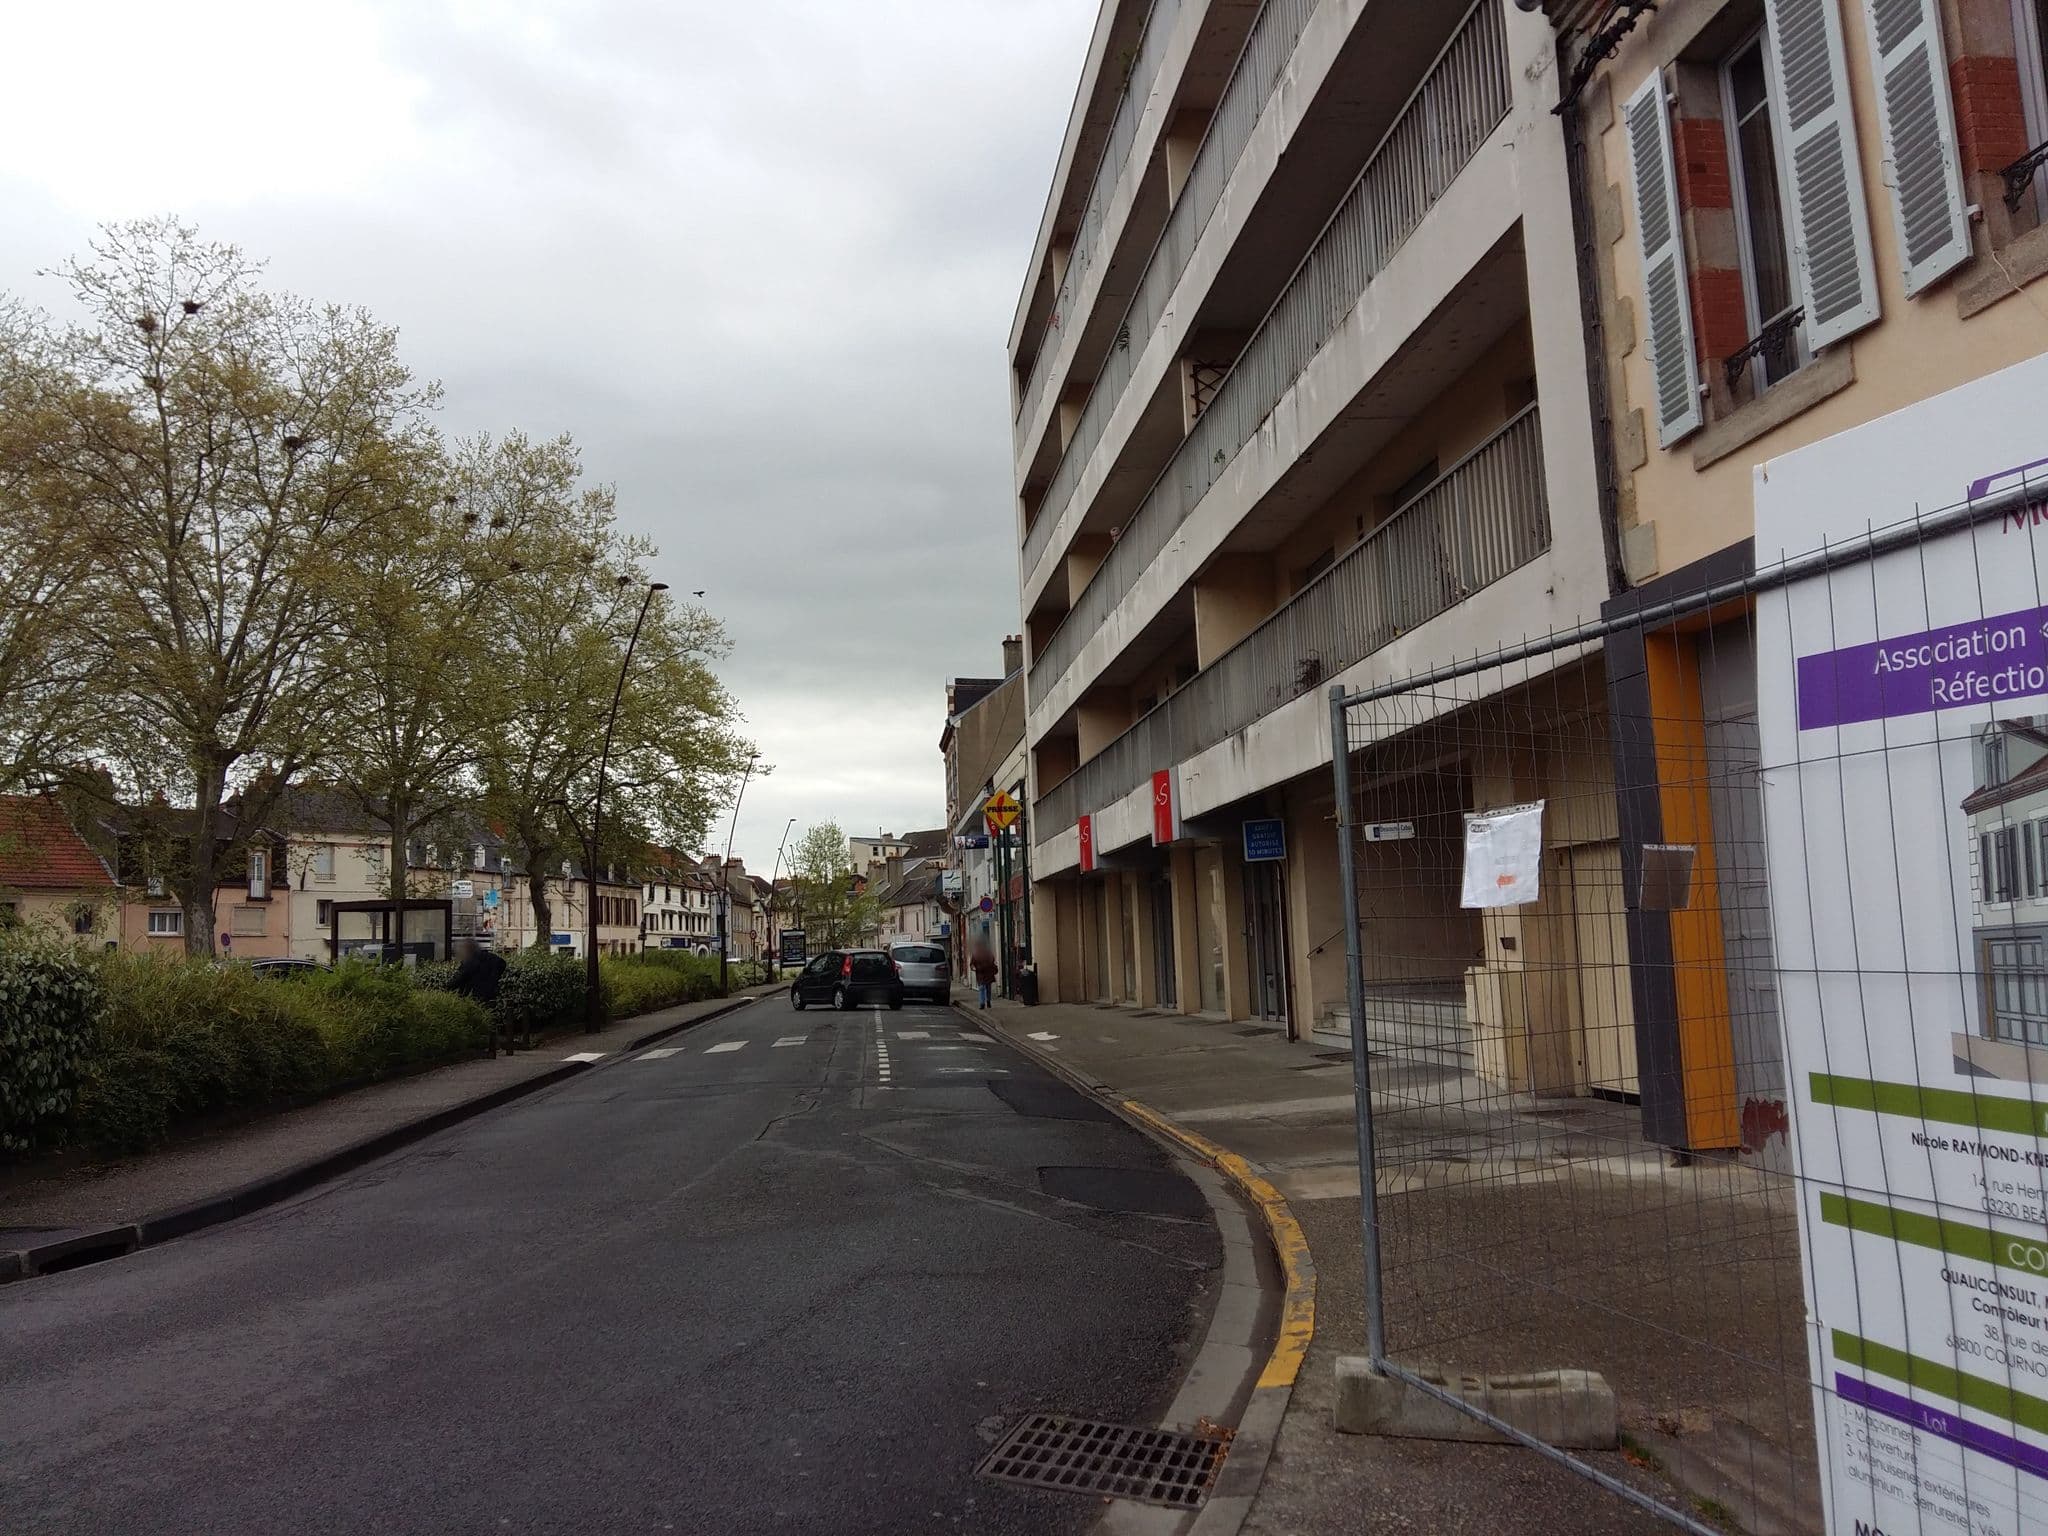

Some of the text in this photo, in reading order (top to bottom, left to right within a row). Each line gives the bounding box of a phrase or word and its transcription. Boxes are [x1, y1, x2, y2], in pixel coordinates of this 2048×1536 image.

[1873, 627, 2026, 675] Association
[1930, 662, 2048, 706] Réfectio
[1911, 1132, 1949, 1151] Nicole
[1992, 1180, 2015, 1195] rue
[2008, 1243, 2048, 1271] CO
[1984, 1324, 2000, 1341] 38
[2005, 1333, 2027, 1350] rue
[1855, 1408, 1922, 1447] Maçonnerie
[1922, 1410, 1948, 1433] Lot
[1856, 1429, 1919, 1465] Couverture
